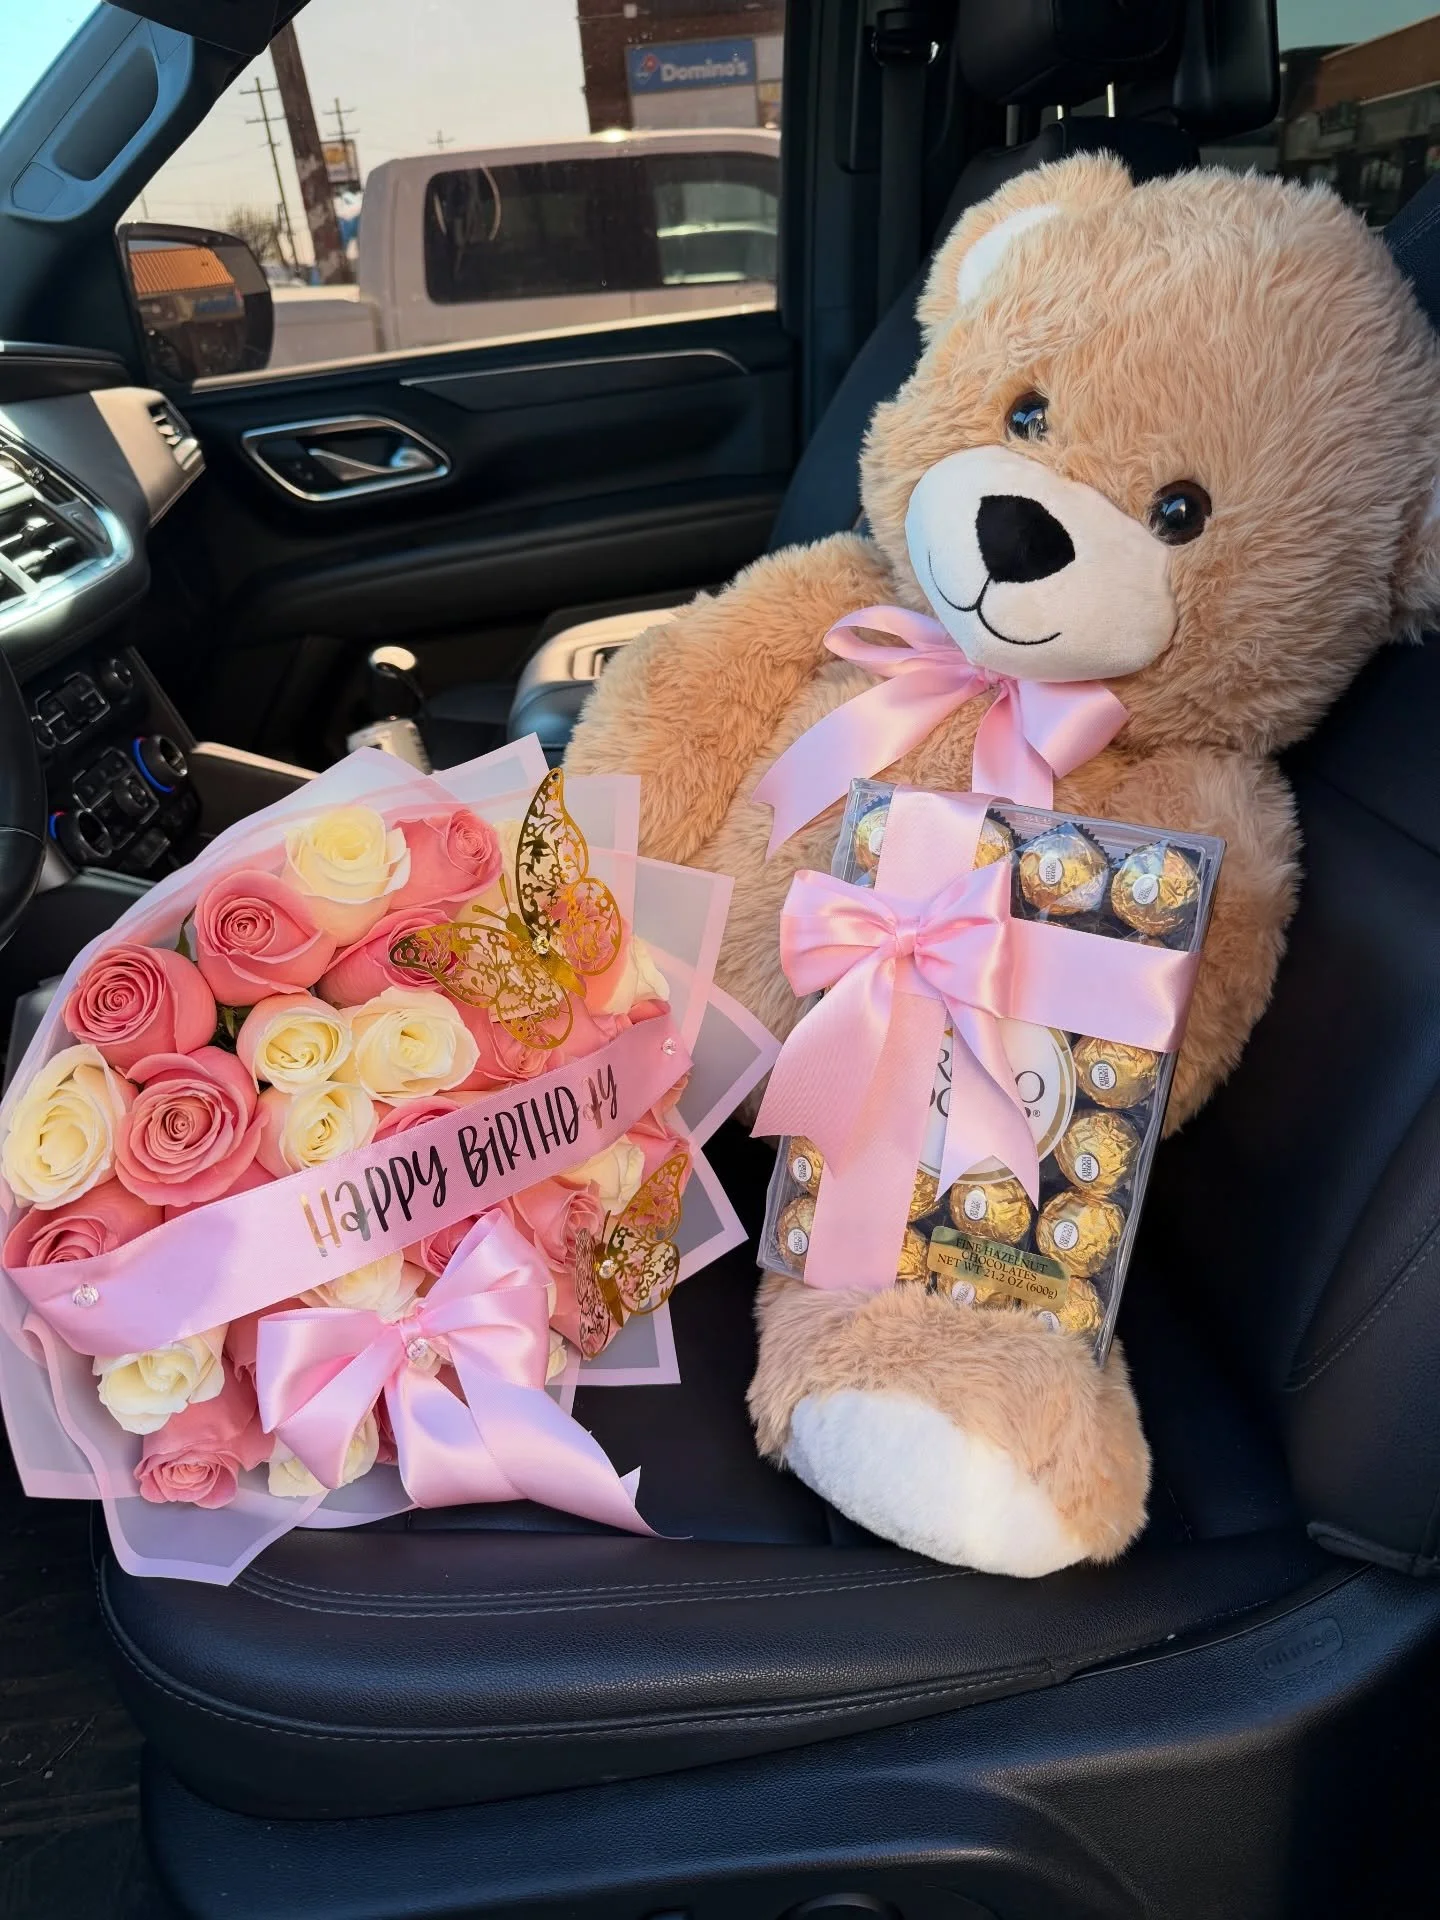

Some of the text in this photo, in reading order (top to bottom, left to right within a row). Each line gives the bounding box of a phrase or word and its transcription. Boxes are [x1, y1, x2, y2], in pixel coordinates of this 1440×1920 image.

[661, 58, 748, 82] Domino's
[300, 1144, 448, 1257] HAPPY
[955, 1237, 1048, 1273] FINE HAZELNUT
[961, 1251, 1037, 1281] CHOCOLATES
[937, 1253, 1058, 1299] NET WT 21.2 OZ (600g)
